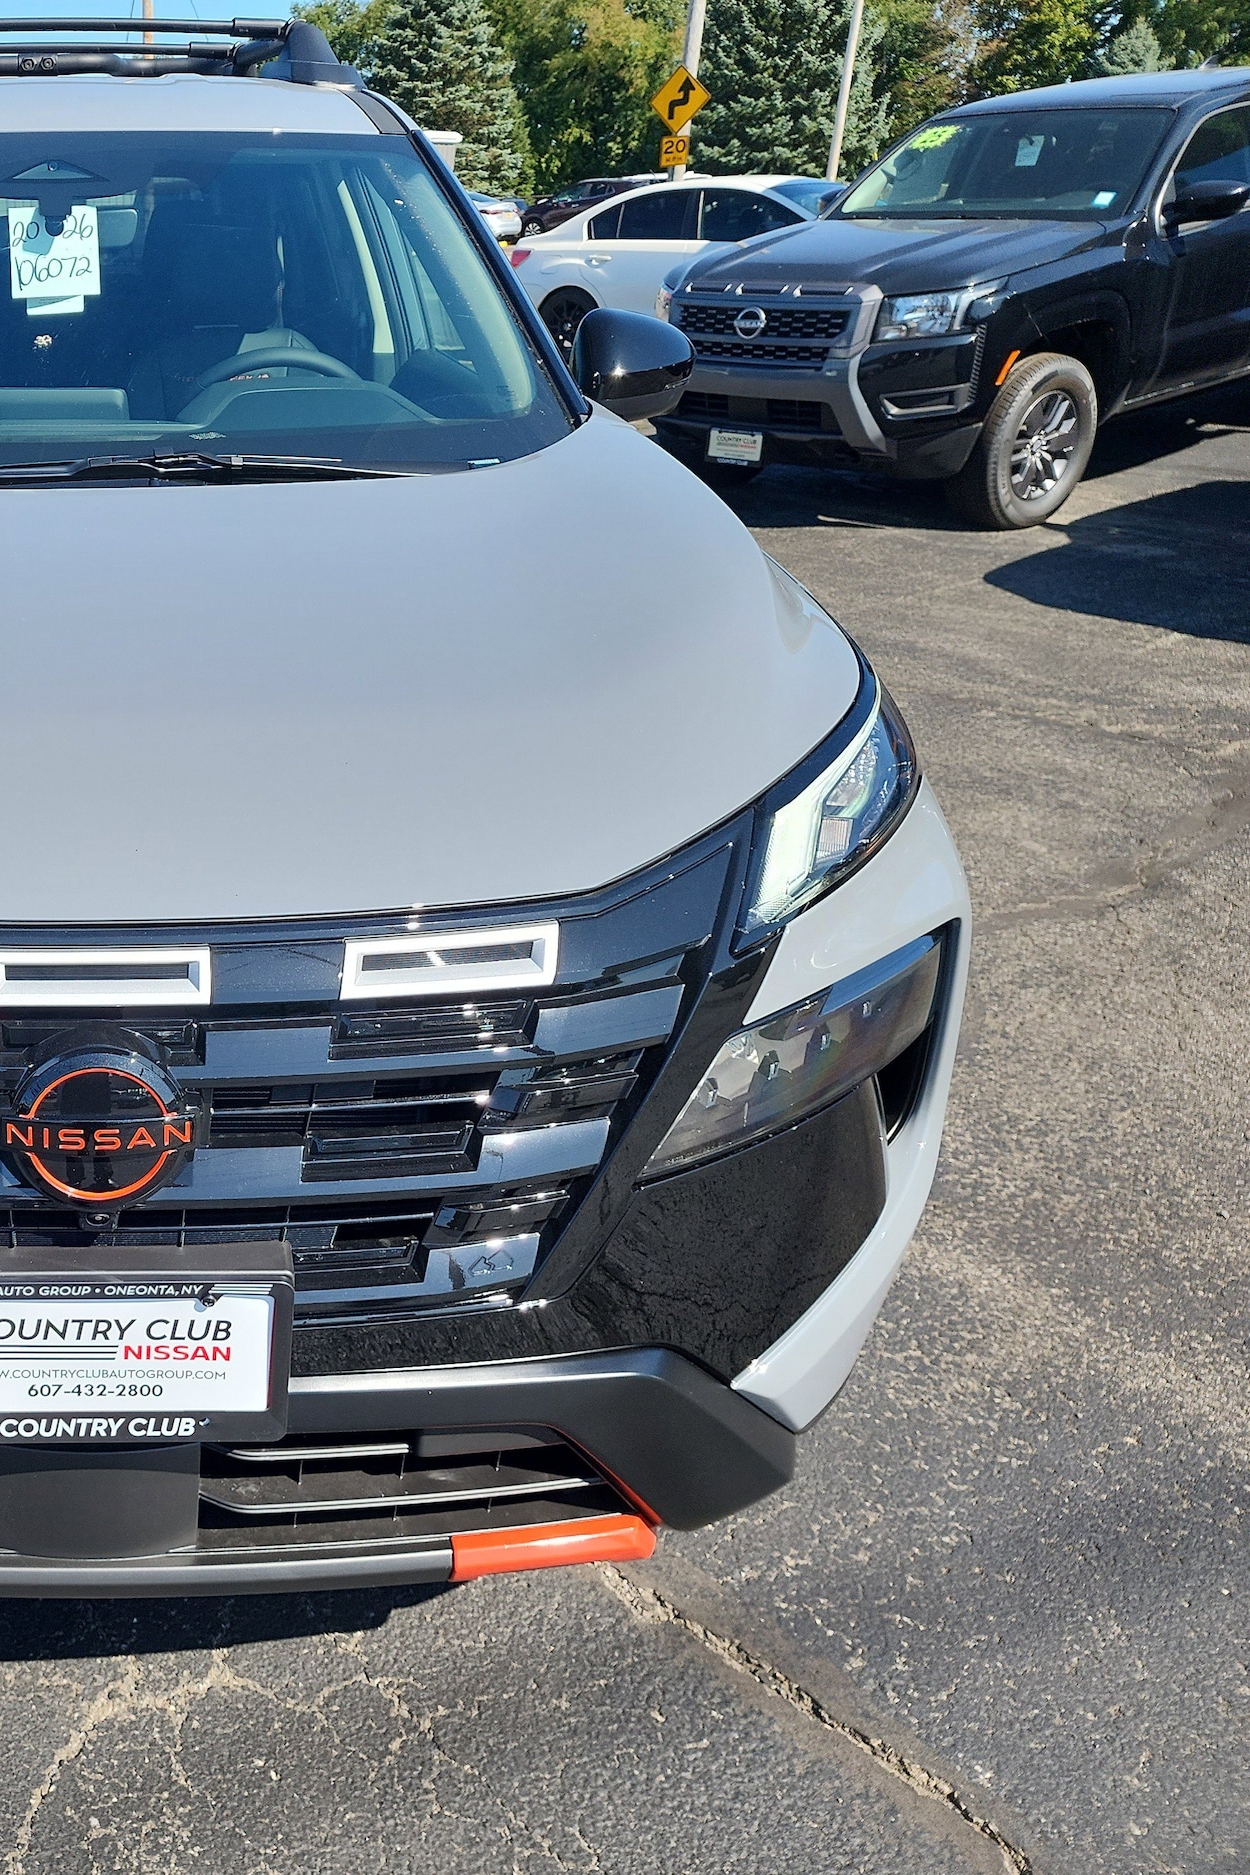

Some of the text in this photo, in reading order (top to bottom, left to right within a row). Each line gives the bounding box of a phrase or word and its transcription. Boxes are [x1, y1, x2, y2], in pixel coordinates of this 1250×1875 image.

[664, 139, 686, 154] 20
[12, 213, 94, 248] 20 26
[6, 1121, 191, 1151] NISSAN
[38, 1285, 92, 1297] GROUP
[145, 1319, 232, 1341] CLUB
[123, 1345, 231, 1361] NISSAN
[27, 1384, 164, 1397] 607-432-2800
[0, 1417, 196, 1438] COUNTRY CLUB
